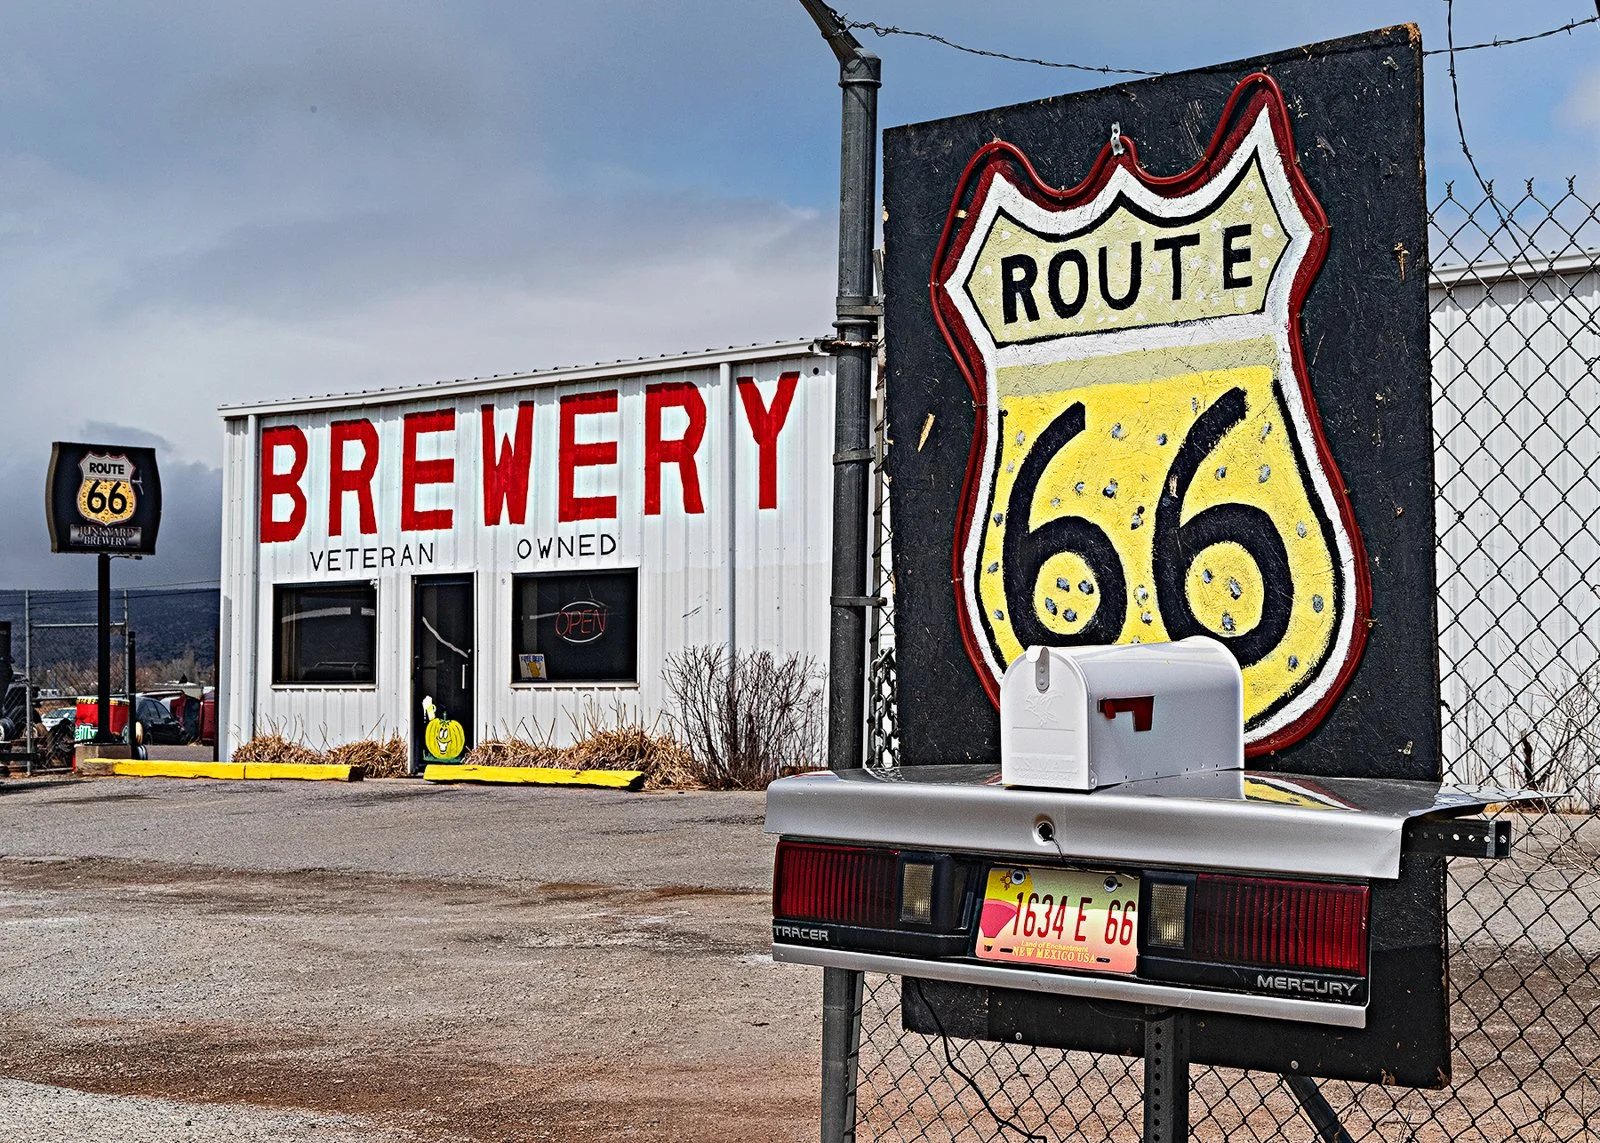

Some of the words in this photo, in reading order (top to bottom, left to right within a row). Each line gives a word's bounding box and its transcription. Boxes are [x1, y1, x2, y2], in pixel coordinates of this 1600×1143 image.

[1001, 224, 1253, 325] ROUTE
[89, 462, 125, 475] ROUTE
[260, 371, 800, 544] BREWERY
[86, 480, 128, 515] 66
[83, 535, 128, 546] BREWERY
[1002, 386, 1295, 669] 66
[309, 542, 435, 572] VETERAN
[516, 533, 618, 561] OWNED
[555, 608, 607, 636] OPEN
[1013, 891, 1068, 940] 1634
[1074, 896, 1092, 942] E
[1104, 899, 1136, 946] 66
[772, 925, 829, 941] TRACER
[1021, 940, 1037, 948] Land
[1046, 942, 1089, 953] Enchantment
[1012, 945, 1035, 957] NEW
[1036, 948, 1075, 961] MEXICO
[1076, 952, 1096, 963] USA
[1257, 974, 1360, 997] MERCURY
